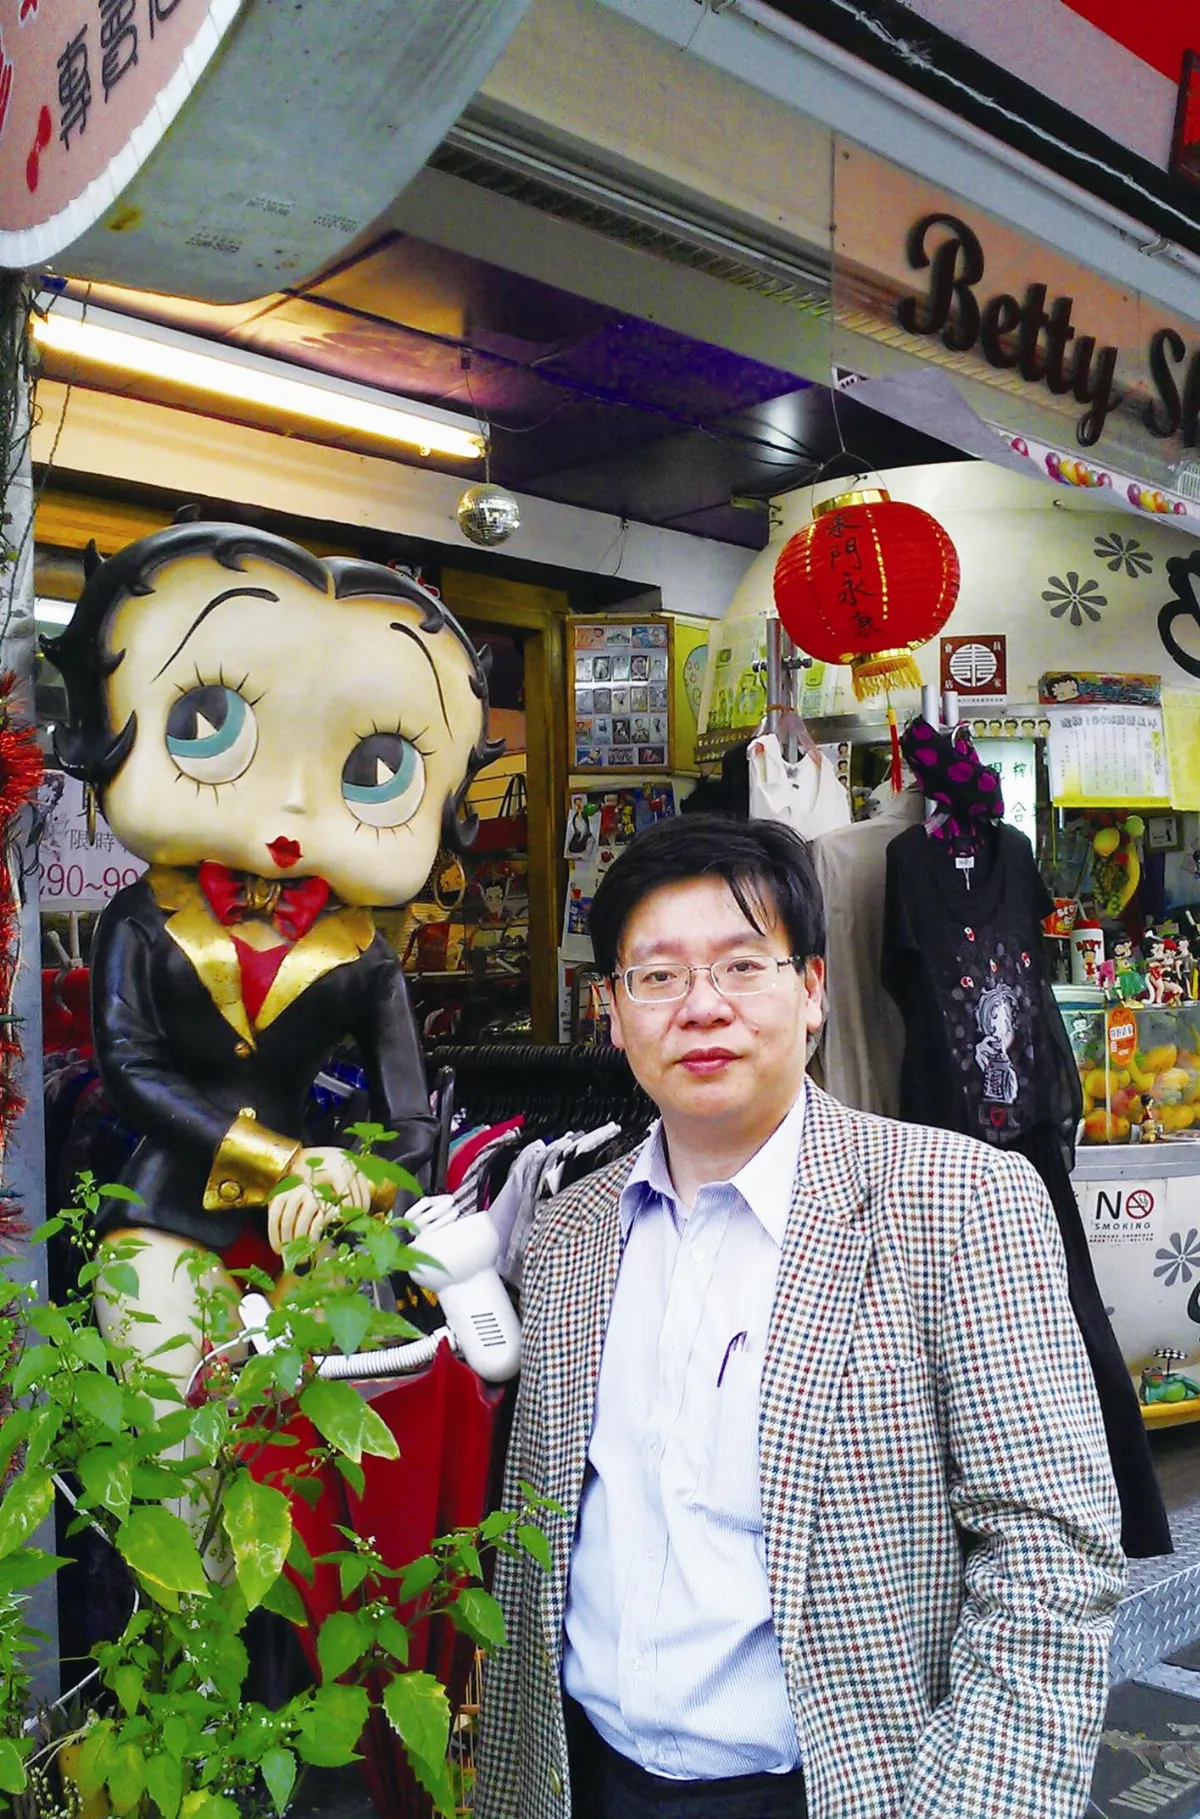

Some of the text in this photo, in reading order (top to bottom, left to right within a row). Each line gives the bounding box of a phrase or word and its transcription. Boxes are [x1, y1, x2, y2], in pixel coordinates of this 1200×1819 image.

[897, 212, 1120, 448] Betty
[69, 829, 127, 853] 限時
[1094, 1221, 1151, 1231] SMOKING
